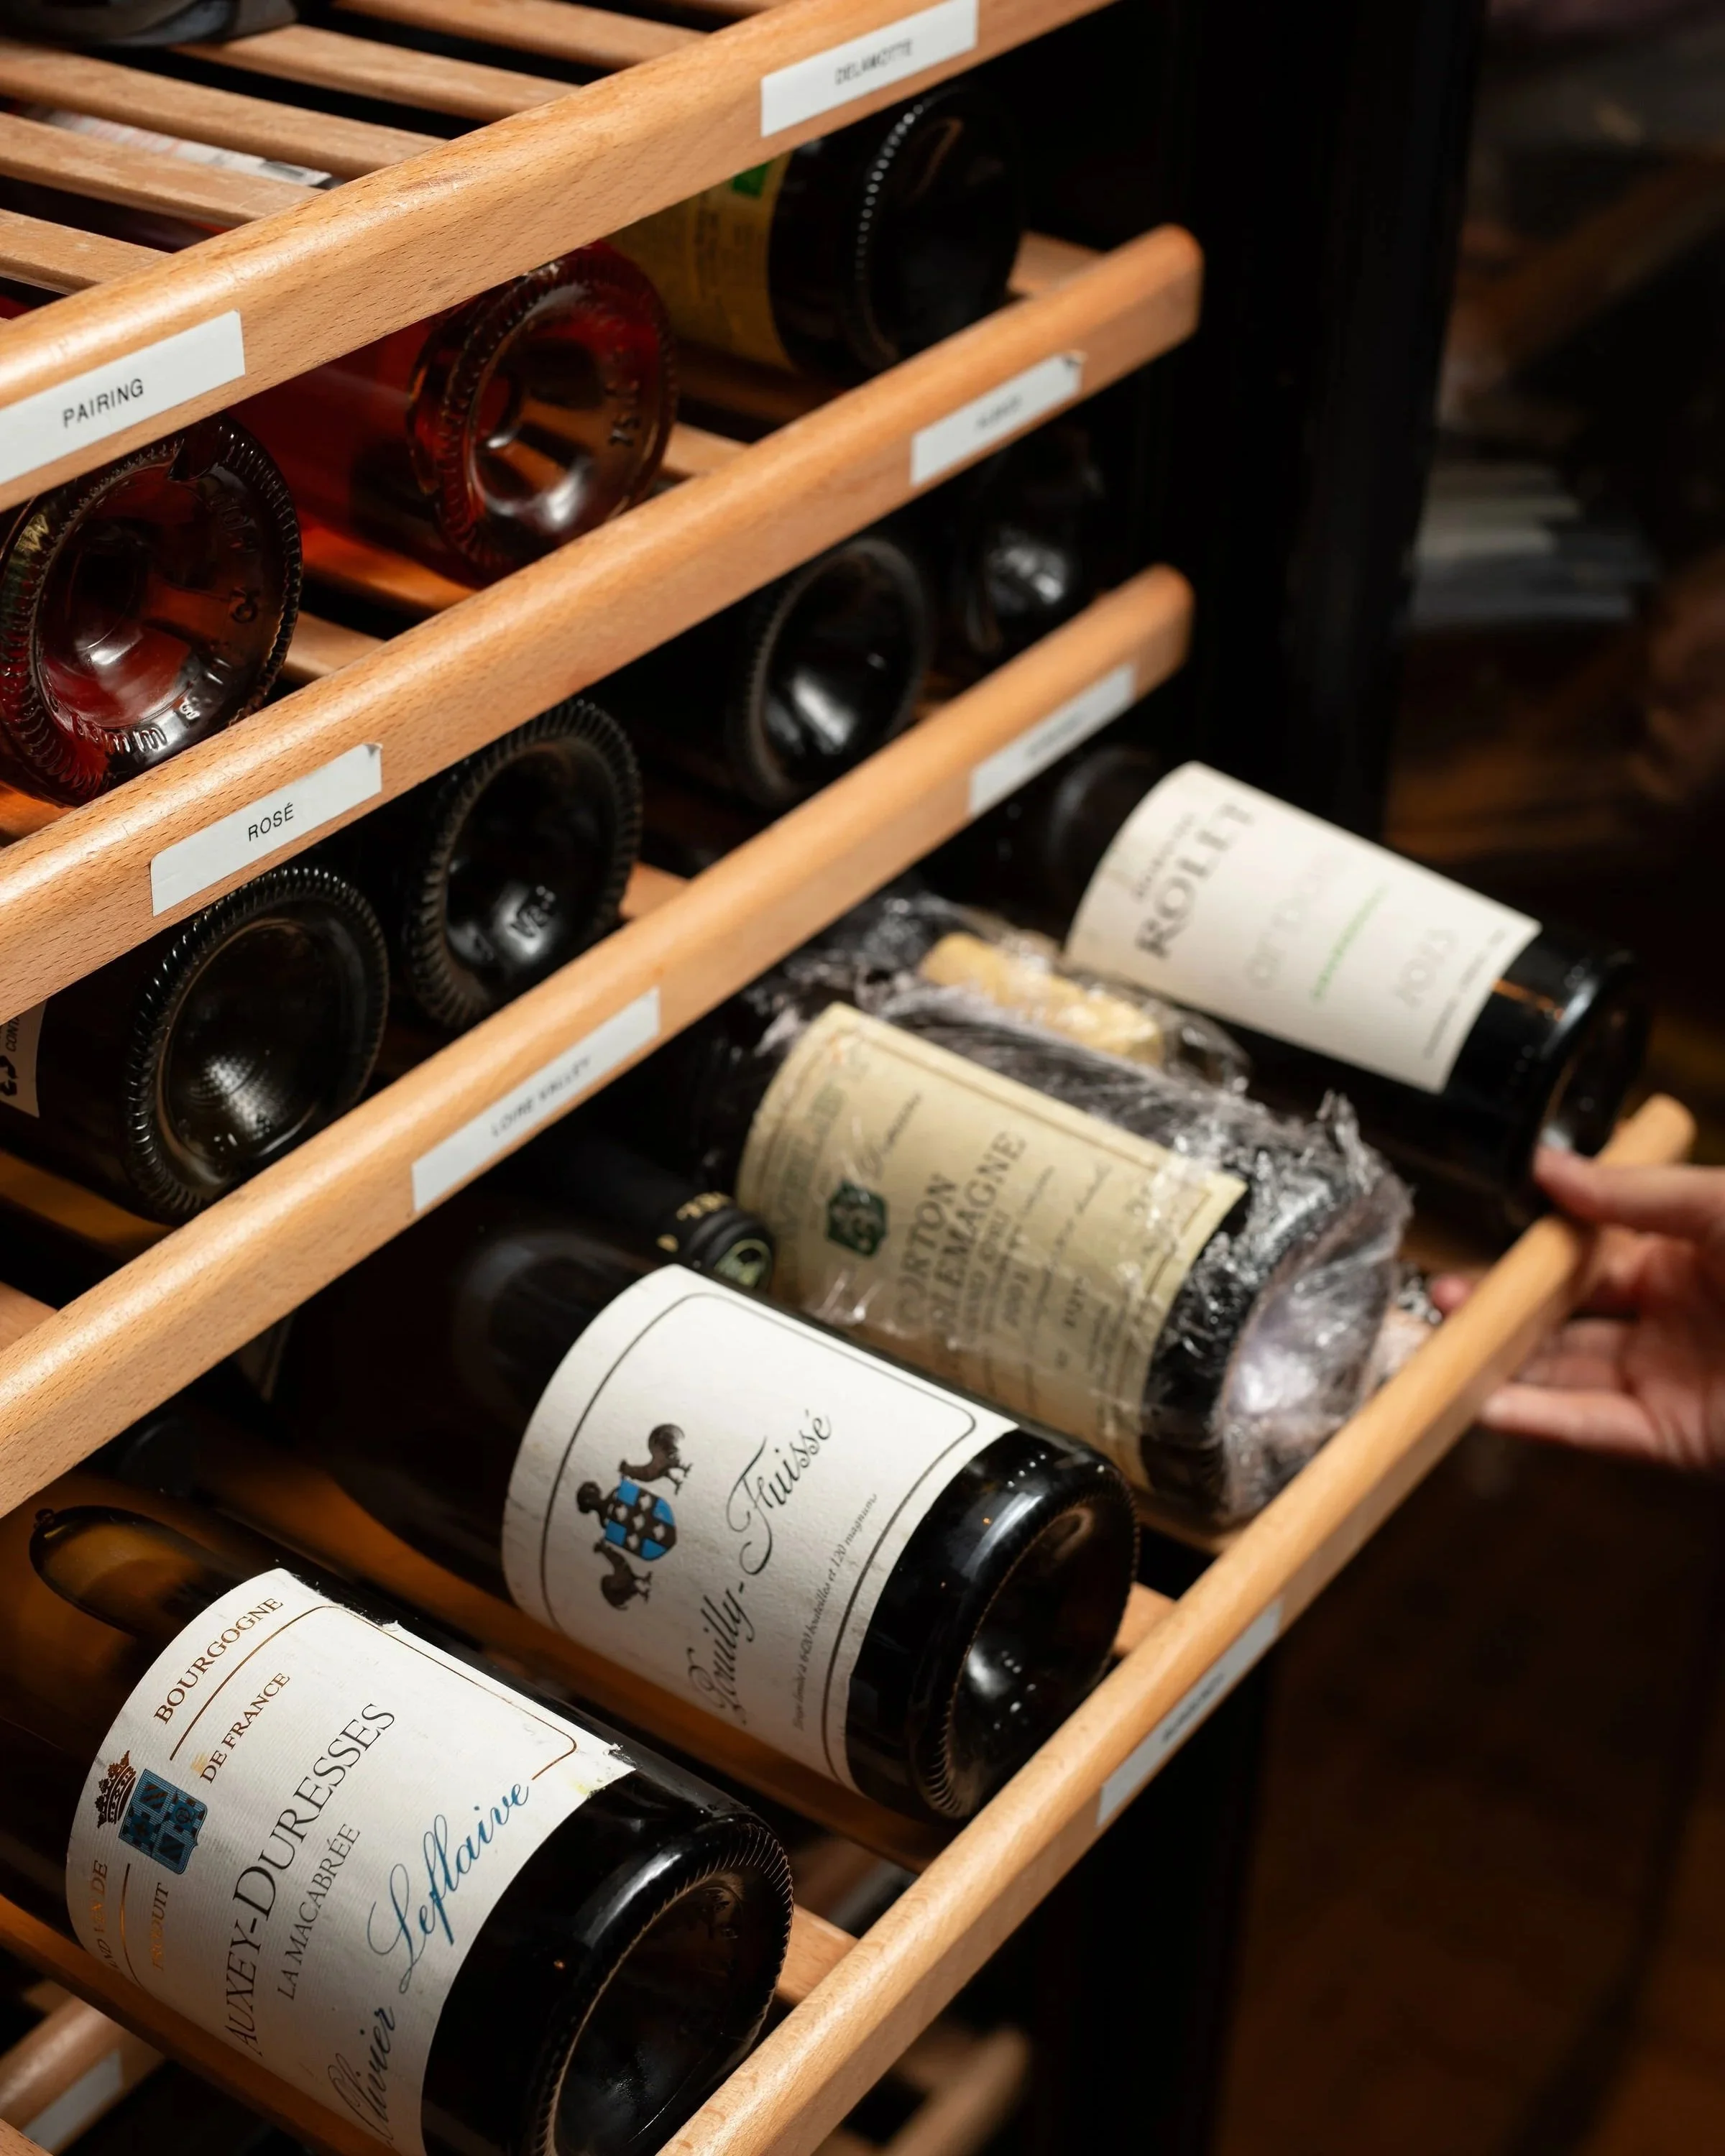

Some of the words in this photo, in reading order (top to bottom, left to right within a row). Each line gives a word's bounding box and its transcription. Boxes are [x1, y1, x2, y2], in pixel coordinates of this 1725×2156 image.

[835, 38, 914, 86] DELAMOTTE
[63, 378, 144, 428] PAIRING
[248, 802, 294, 842] ROSÉ
[491, 1095, 534, 1138] LOIRE
[538, 1054, 592, 1102] VALLEY
[844, 1493, 878, 1546] magnums
[828, 1568, 837, 1582] et
[831, 1543, 847, 1567] 120
[153, 1598, 284, 1725] BOURGOGNE
[200, 1750, 228, 1784] DE
[221, 1672, 291, 1750] FRANCE
[91, 1860, 109, 1897] DE
[224, 1703, 395, 2058] AUXEY-DURESSES
[367, 1783, 530, 1994] Leflaive
[277, 1968, 299, 2001] LA
[293, 1823, 361, 1966] MACABRÉE
